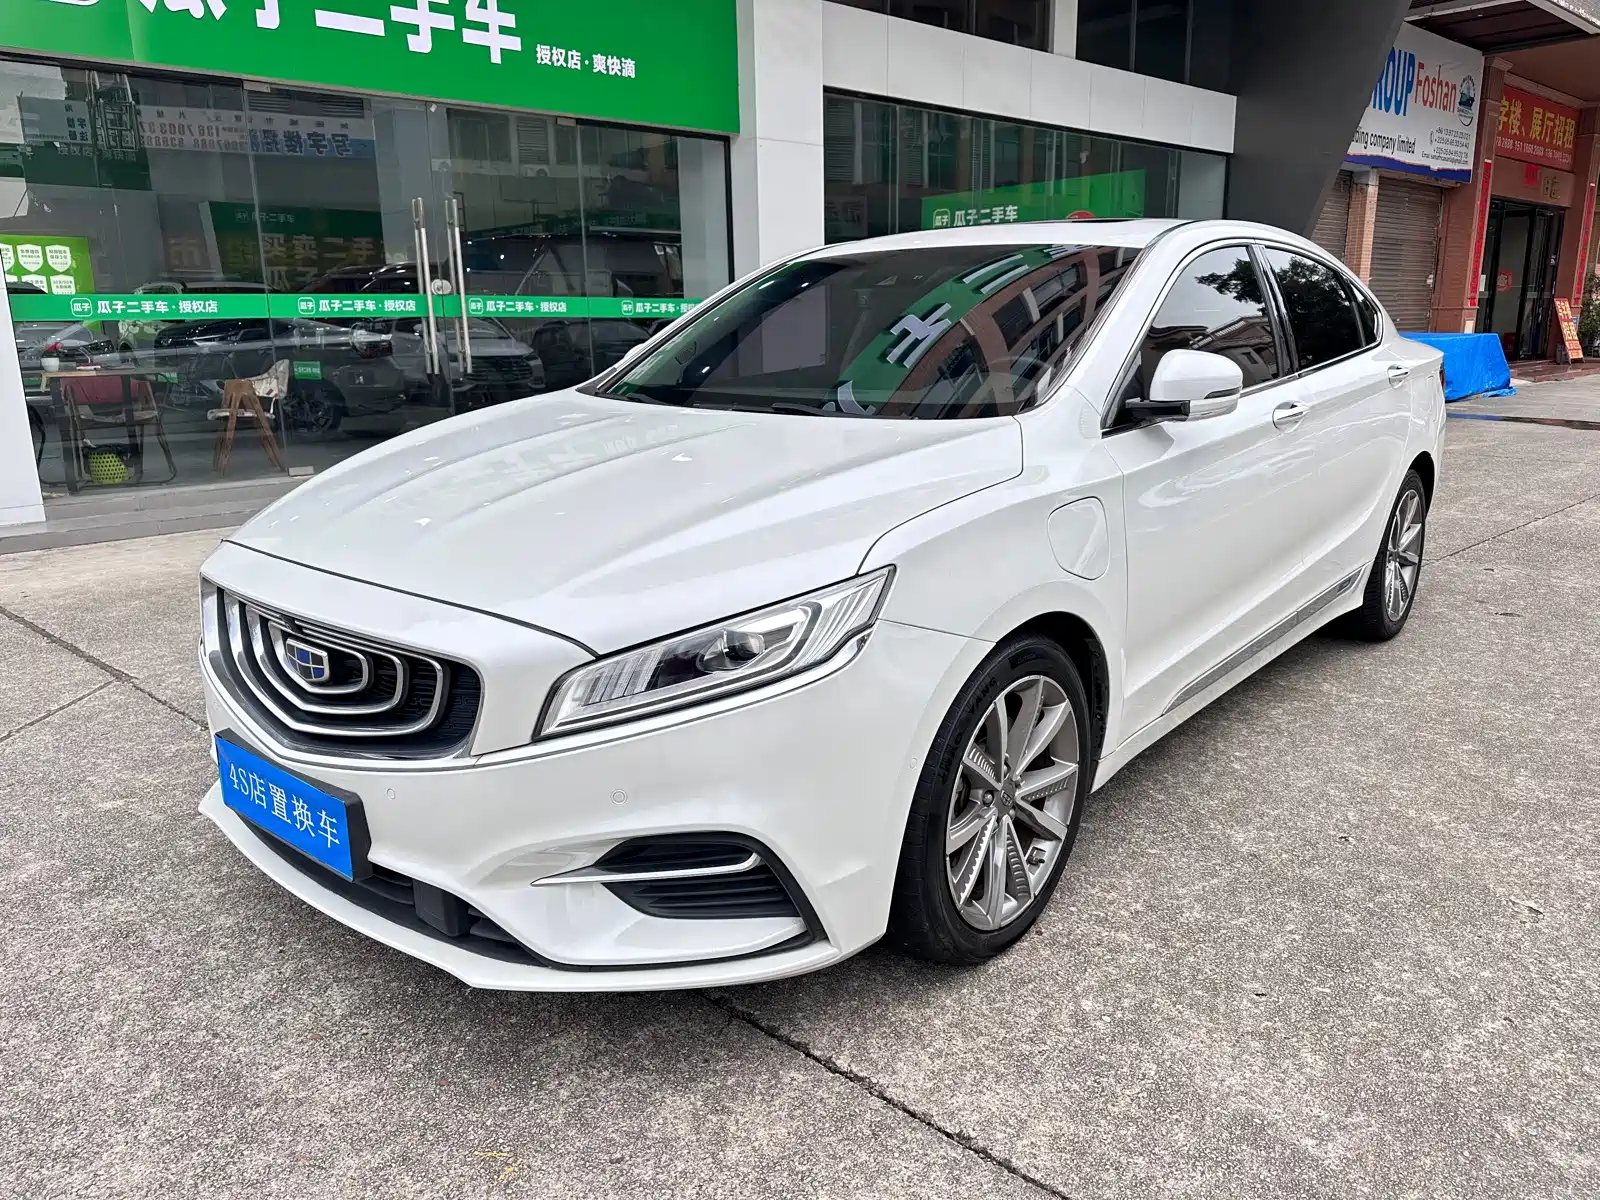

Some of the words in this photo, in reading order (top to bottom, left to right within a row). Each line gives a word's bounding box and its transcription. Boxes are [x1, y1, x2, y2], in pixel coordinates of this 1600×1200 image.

[536, 43, 636, 79] 授权店·爽快滴
[1414, 61, 1457, 114] Foshan
[1370, 131, 1396, 154] company
[1396, 134, 1416, 155] limited
[953, 205, 1018, 227] 瓜子二手车
[97, 300, 218, 314] 瓜子二手车·授权店
[319, 300, 416, 312] 瓜子二手车·授权店
[486, 300, 567, 313] 瓜子二手车·授权店
[228, 763, 340, 848] 4S店置换车
